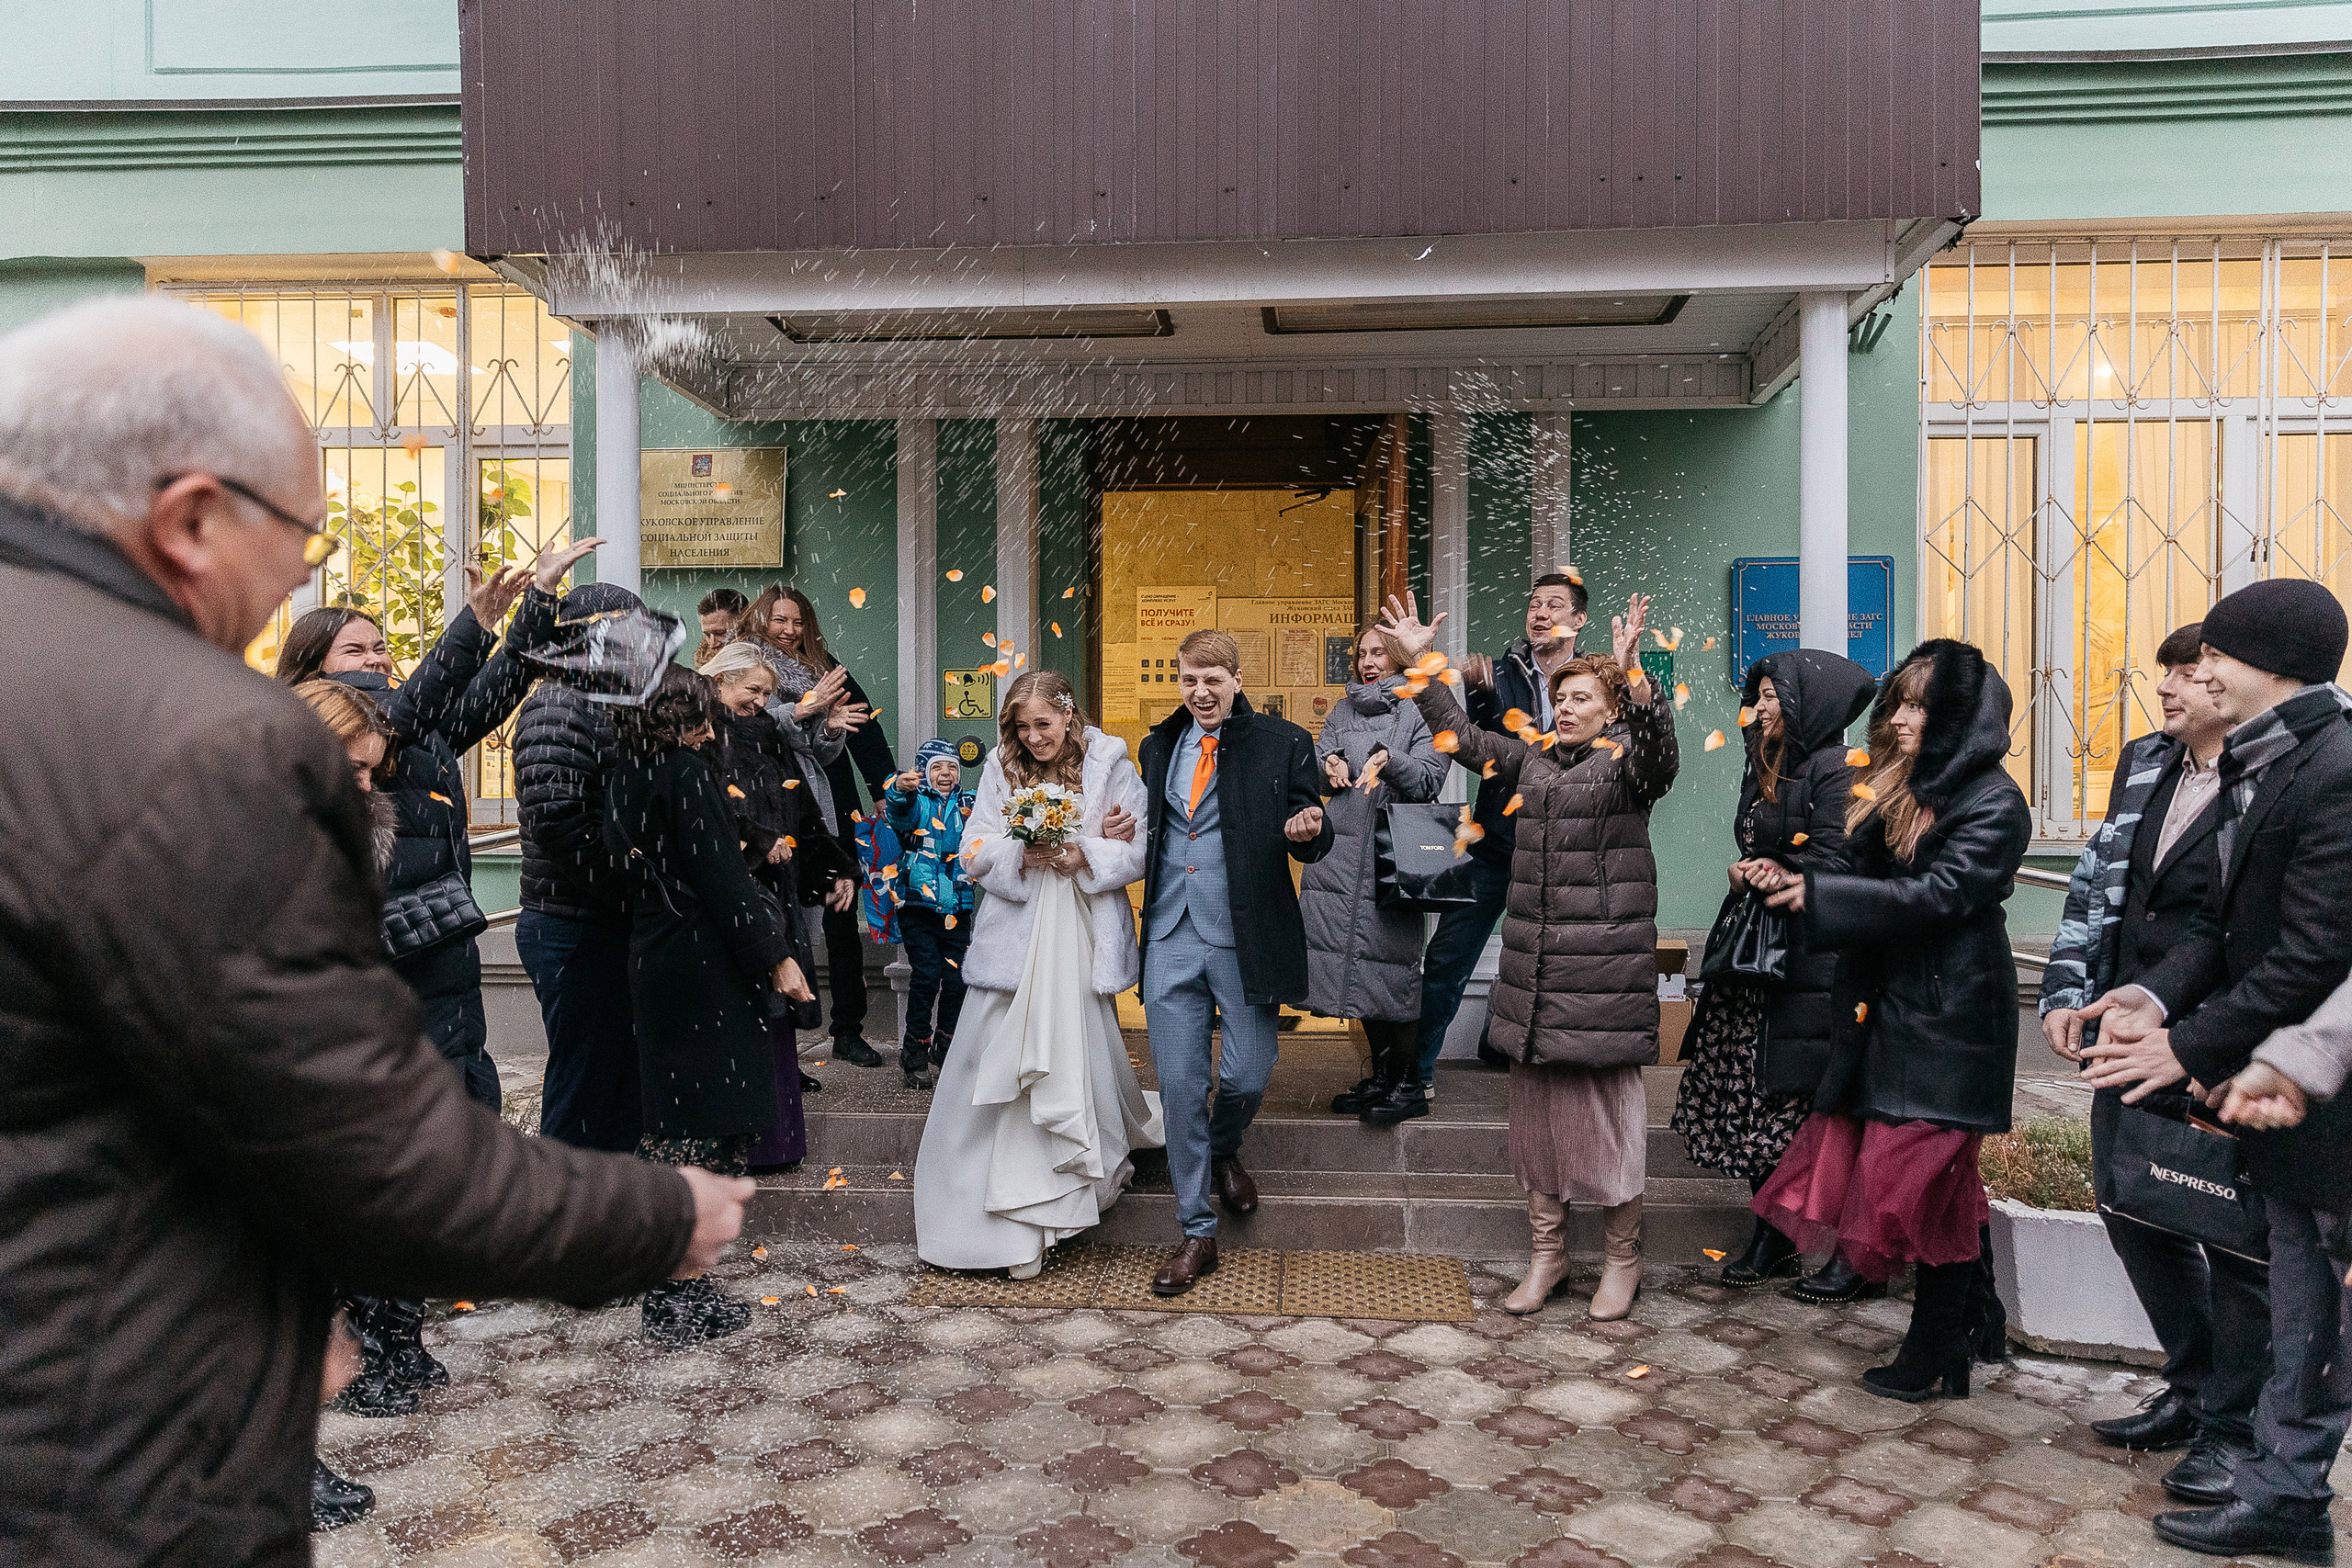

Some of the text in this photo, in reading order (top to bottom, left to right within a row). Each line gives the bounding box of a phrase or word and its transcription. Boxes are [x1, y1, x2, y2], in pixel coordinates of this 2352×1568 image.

[658, 490, 708, 498] СОЦИАЛЬНОГО
[661, 497, 707, 505] МОСКОВСКОЙ
[700, 516, 764, 525] УПРАВЛЕНИЕ
[640, 532, 758, 542] СОЦИАЛЬНОЙ ЗАЩИТЫ
[670, 548, 729, 558] НАСЕЛЕНИЯ
[1141, 609, 1194, 617] ПОЛУЧИТЕ
[1860, 613, 1883, 621] ЗАГС
[1141, 618, 1156, 626] ВСЁ
[1747, 614, 1791, 622] ГЛАВНОЕ
[2150, 1161, 2236, 1201] NESPRESSO
